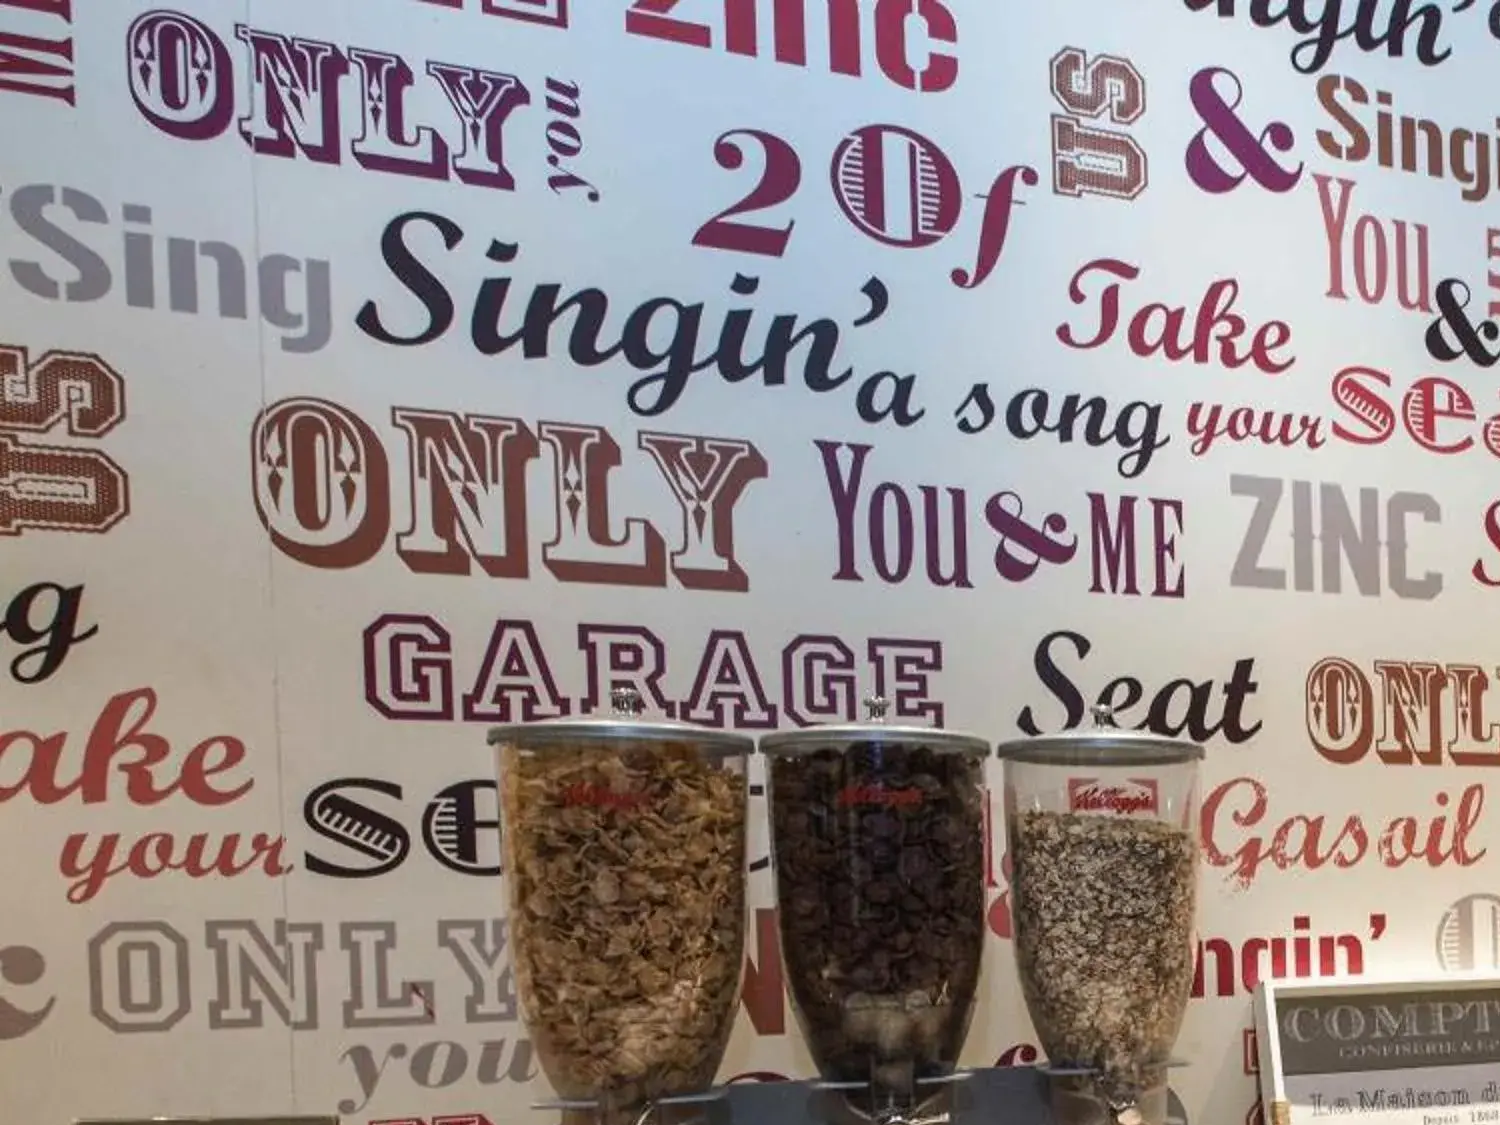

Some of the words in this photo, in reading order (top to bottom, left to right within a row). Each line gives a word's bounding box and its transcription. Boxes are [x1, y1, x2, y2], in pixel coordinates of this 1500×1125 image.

[127, 9, 530, 191] ONLY
[545, 77, 600, 203] you
[1049, 46, 1148, 200] US
[1185, 67, 1304, 194] &
[8, 184, 332, 354] Sing
[1312, 173, 1433, 315] You
[355, 210, 889, 417] Singin'
[857, 370, 925, 427] a
[954, 382, 1170, 478] song
[1056, 258, 1296, 375] Take
[1185, 400, 1328, 456] your
[0, 344, 131, 536] US
[251, 397, 769, 592] ONLY
[1229, 474, 1443, 601] ZINC
[363, 613, 944, 729] GARAGE
[1016, 631, 1264, 744] Seat
[58, 823, 295, 905] your
[1200, 777, 1487, 894] Gasoil
[87, 918, 518, 1034] ONLY
[337, 1039, 540, 1114] you
[1356, 1086, 1472, 1113] Maison
